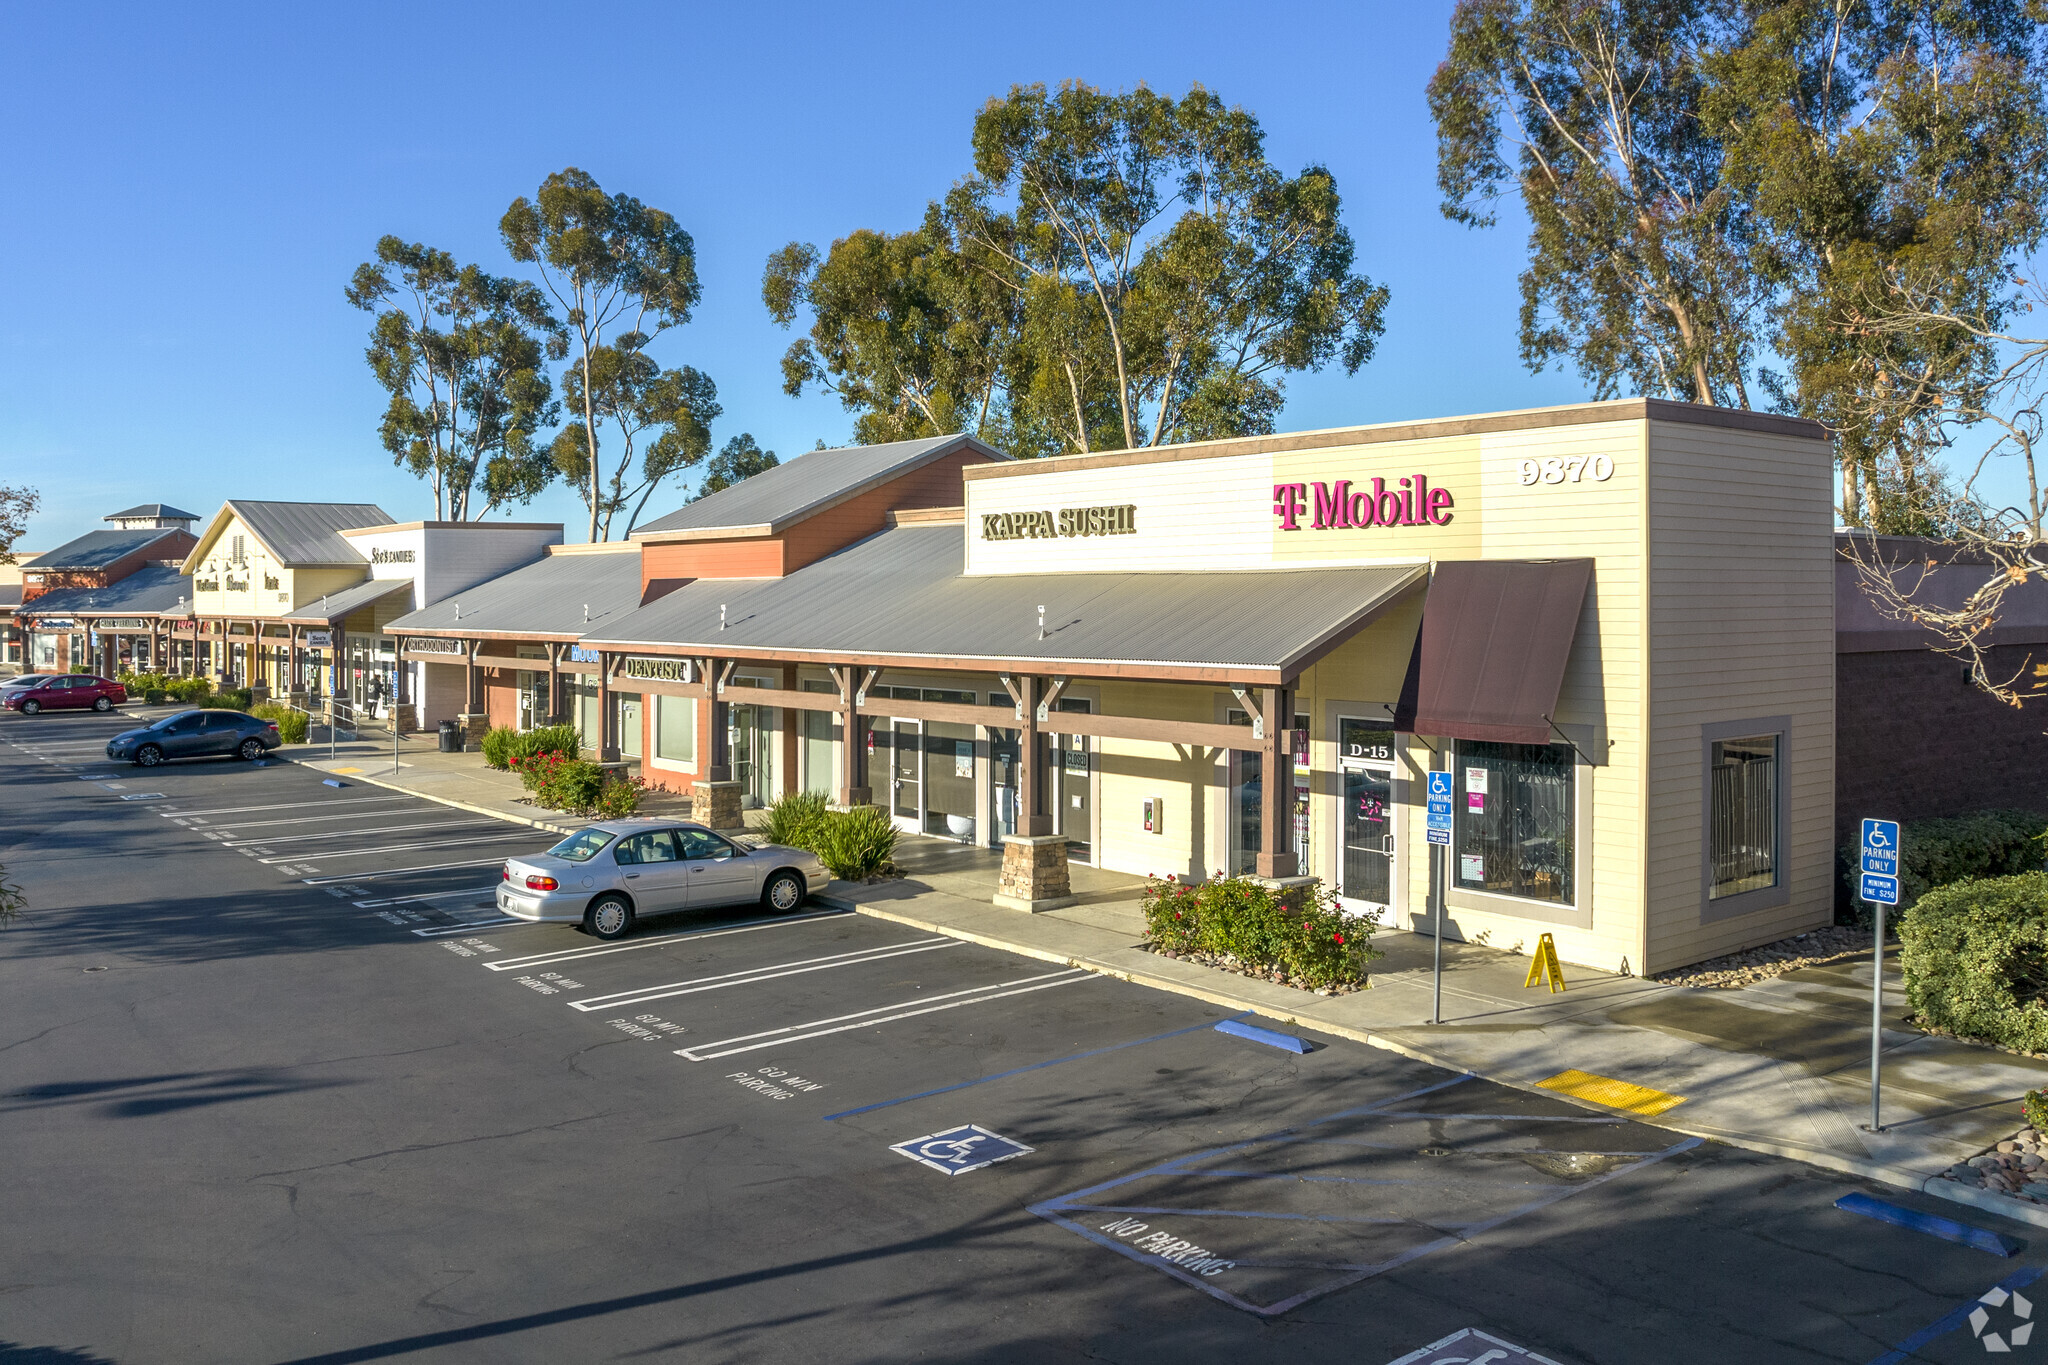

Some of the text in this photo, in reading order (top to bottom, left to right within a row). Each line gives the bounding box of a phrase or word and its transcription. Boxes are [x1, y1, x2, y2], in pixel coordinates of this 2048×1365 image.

[1517, 454, 1614, 485] 9870
[1311, 474, 1452, 528] Mobile
[981, 504, 1135, 541] KAPPA SUSHI
[408, 638, 457, 653] ORTHODONTIST
[625, 659, 683, 680] DENTIST
[1068, 753, 1086, 766] CLOSED
[1350, 743, 1388, 759] D-15
[1428, 793, 1451, 804] PARKING
[1432, 803, 1447, 813] ONLY
[1863, 847, 1896, 860] PARKING
[1869, 859, 1889, 871] ONLY
[1864, 887, 1895, 899] FINE $250
[1868, 879, 1891, 889] MINIMUM
[512, 975, 560, 995] PARKING
[605, 1018, 662, 1041] PARKING
[635, 1014, 688, 1035] 60 MIN
[725, 1071, 795, 1101] PARKING
[757, 1066, 823, 1092] 60 MIN
[1100, 1216, 1236, 1277] NO PARKING
